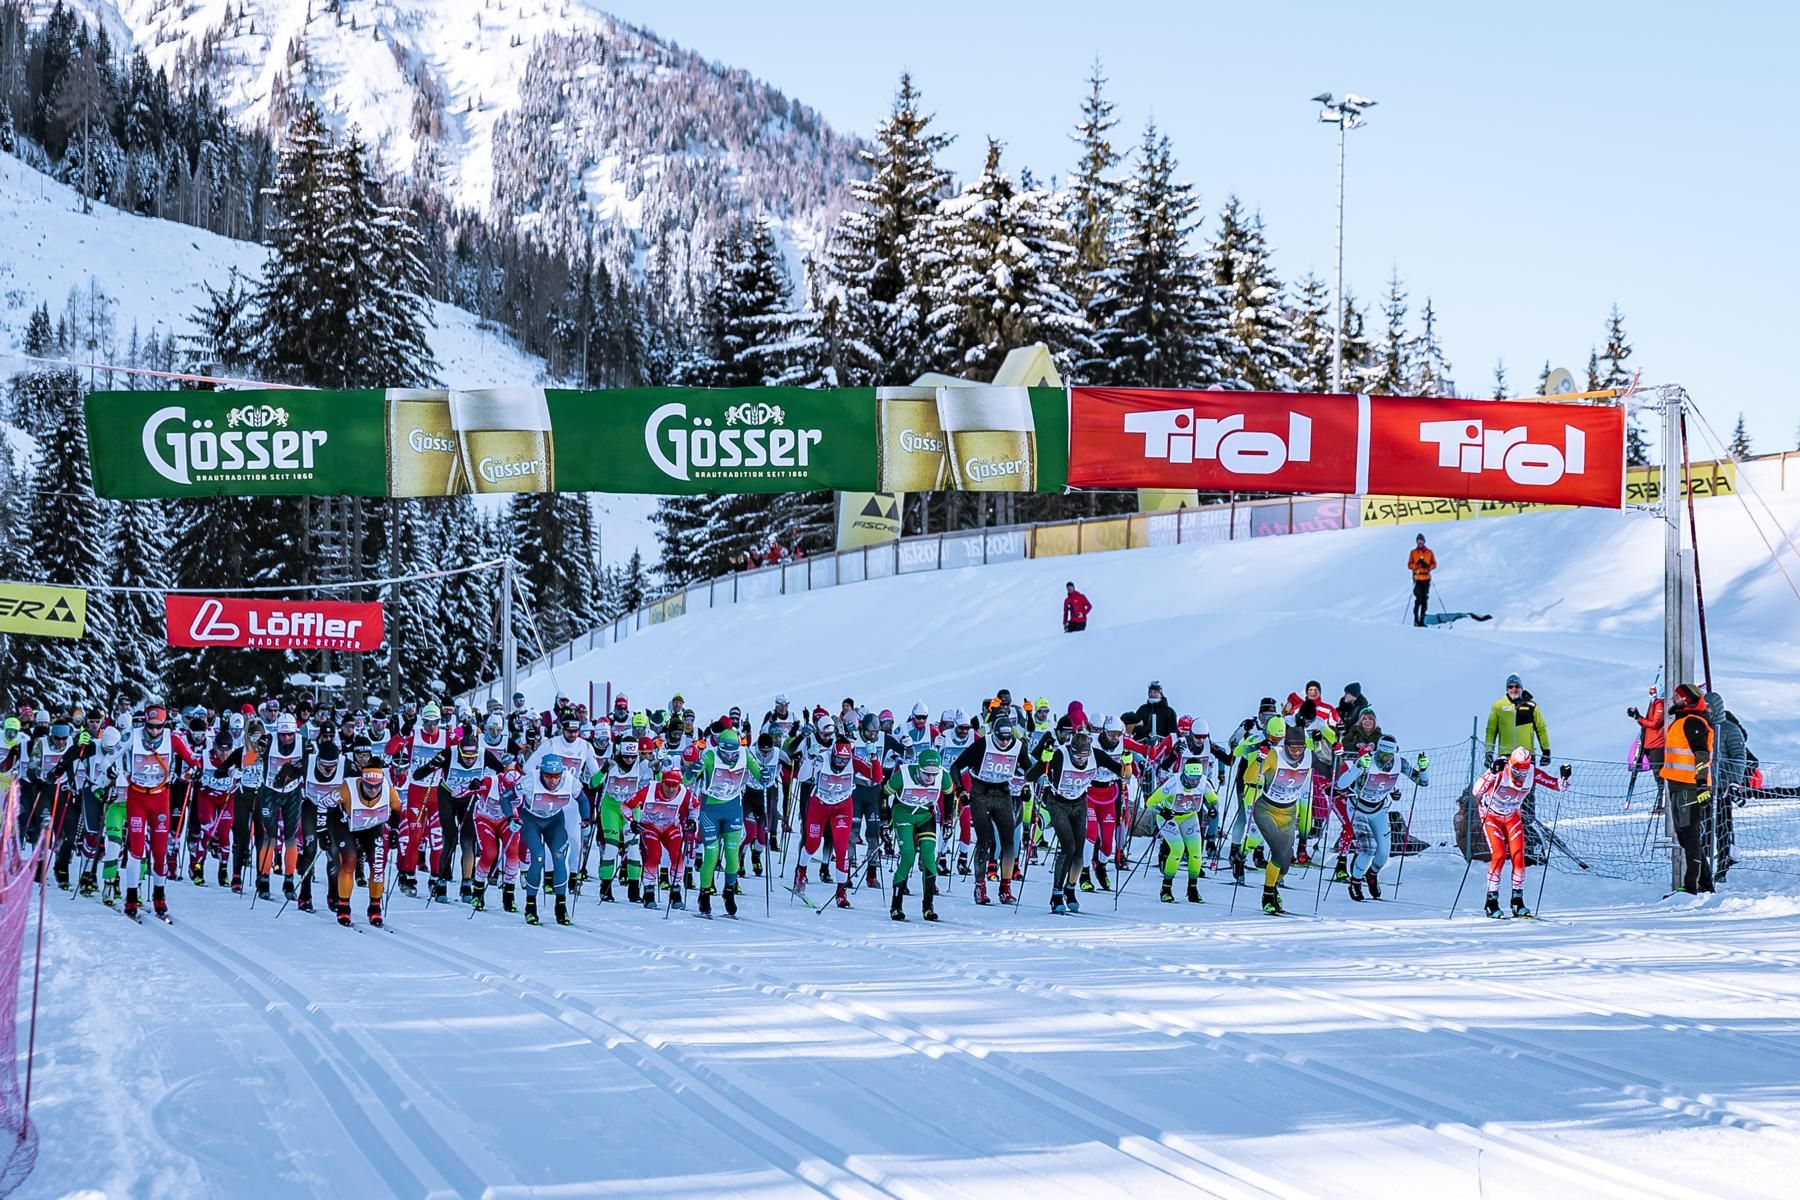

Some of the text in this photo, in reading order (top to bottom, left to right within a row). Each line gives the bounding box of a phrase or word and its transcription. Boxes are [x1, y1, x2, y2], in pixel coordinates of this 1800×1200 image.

[142, 406, 328, 485] Gösser
[408, 428, 456, 454] Gösse
[644, 402, 823, 481] Gösser
[900, 428, 943, 454] Gösse
[1124, 407, 1312, 474] Tirol
[1420, 419, 1586, 486] Tirol
[479, 456, 539, 484] Gösser
[965, 456, 1024, 483] Gösser
[248, 637, 361, 649] MADE FOR BETTER
[142, 763, 160, 775] 25
[985, 762, 1011, 774] 305
[614, 785, 629, 794] 34
[827, 783, 843, 791] 73
[1287, 778, 1296, 788] 2
[1377, 781, 1386, 791] 5
[362, 816, 379, 827] 74
